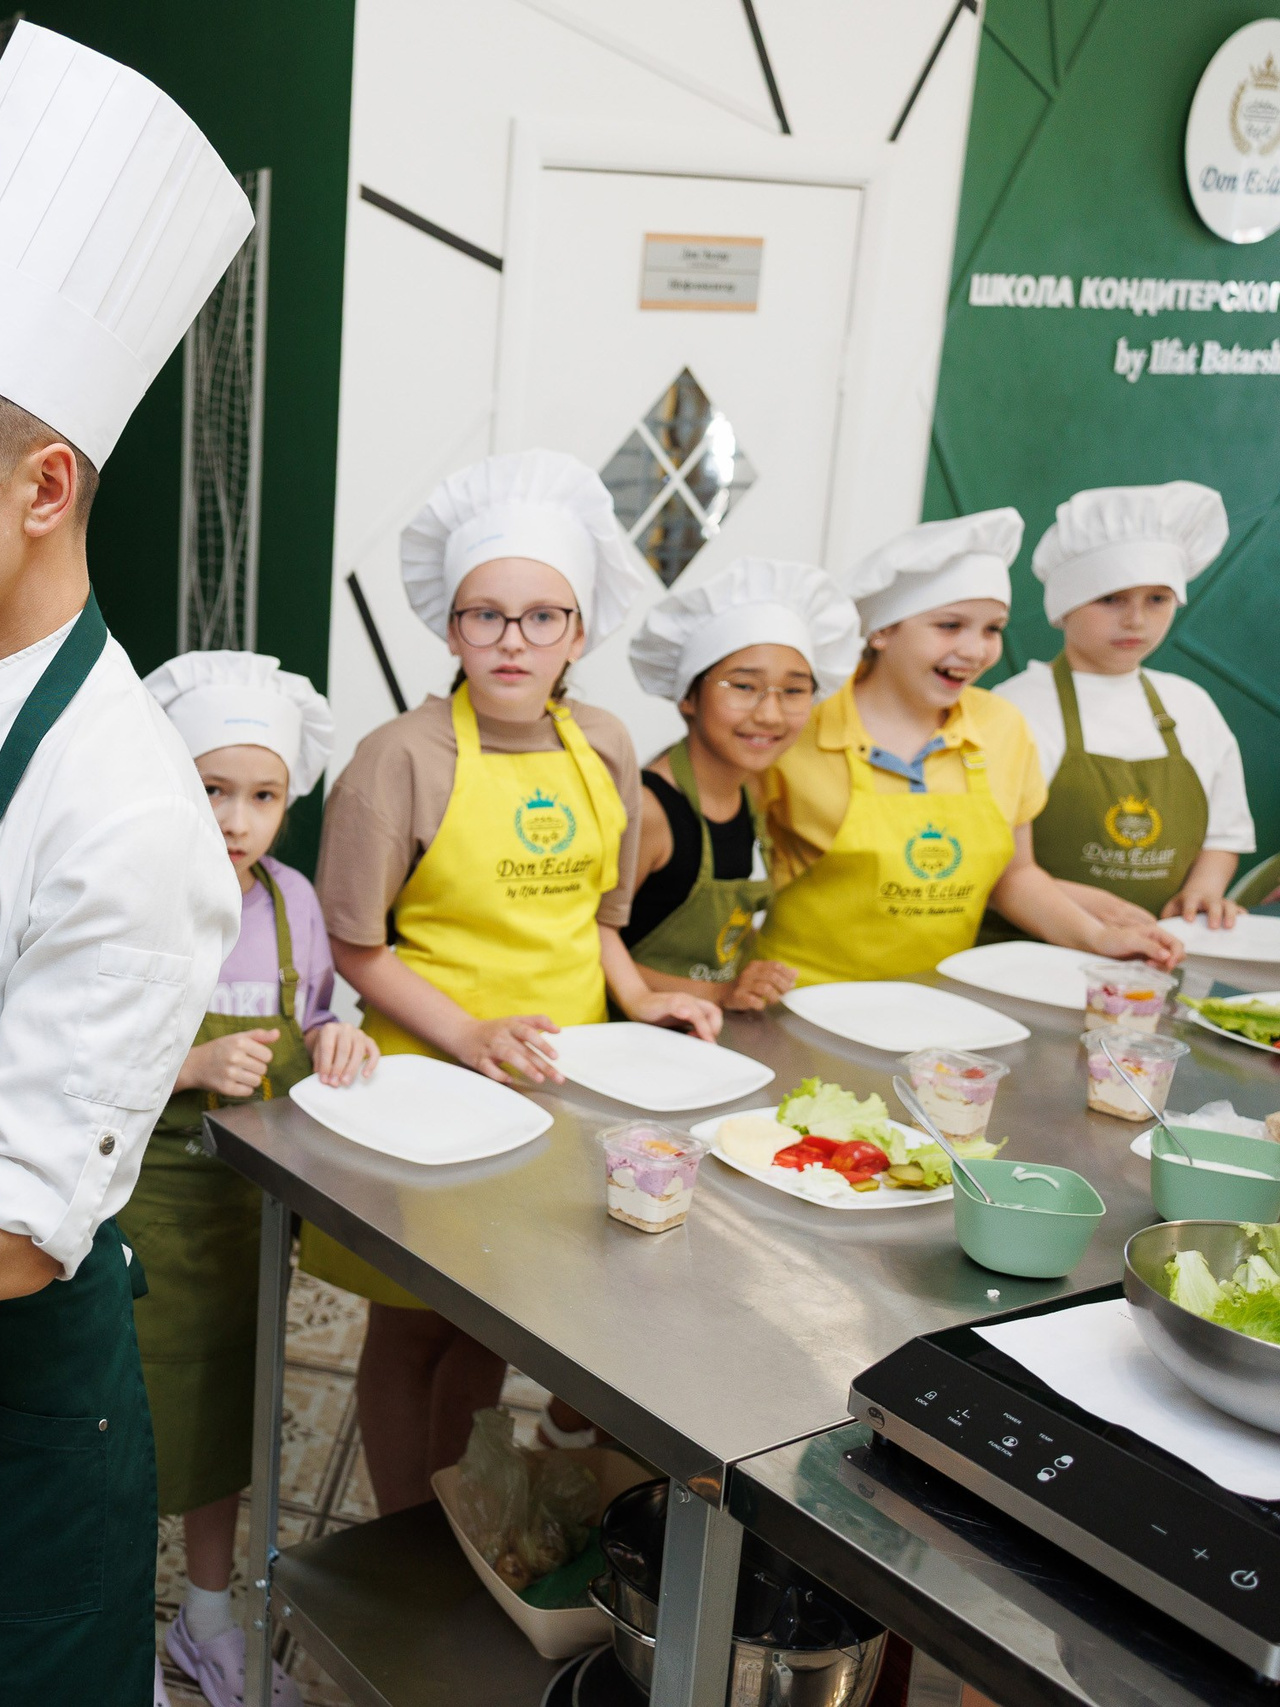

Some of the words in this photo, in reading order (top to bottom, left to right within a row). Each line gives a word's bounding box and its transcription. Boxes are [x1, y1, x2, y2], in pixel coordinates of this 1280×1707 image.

[970, 273, 1074, 308] ШКОЛА
[1114, 336, 1148, 383] by
[496, 857, 536, 877] Don
[915, 1396, 929, 1407] LOCK
[947, 1415, 963, 1427] TIMER
[1003, 1411, 1022, 1425] POWER
